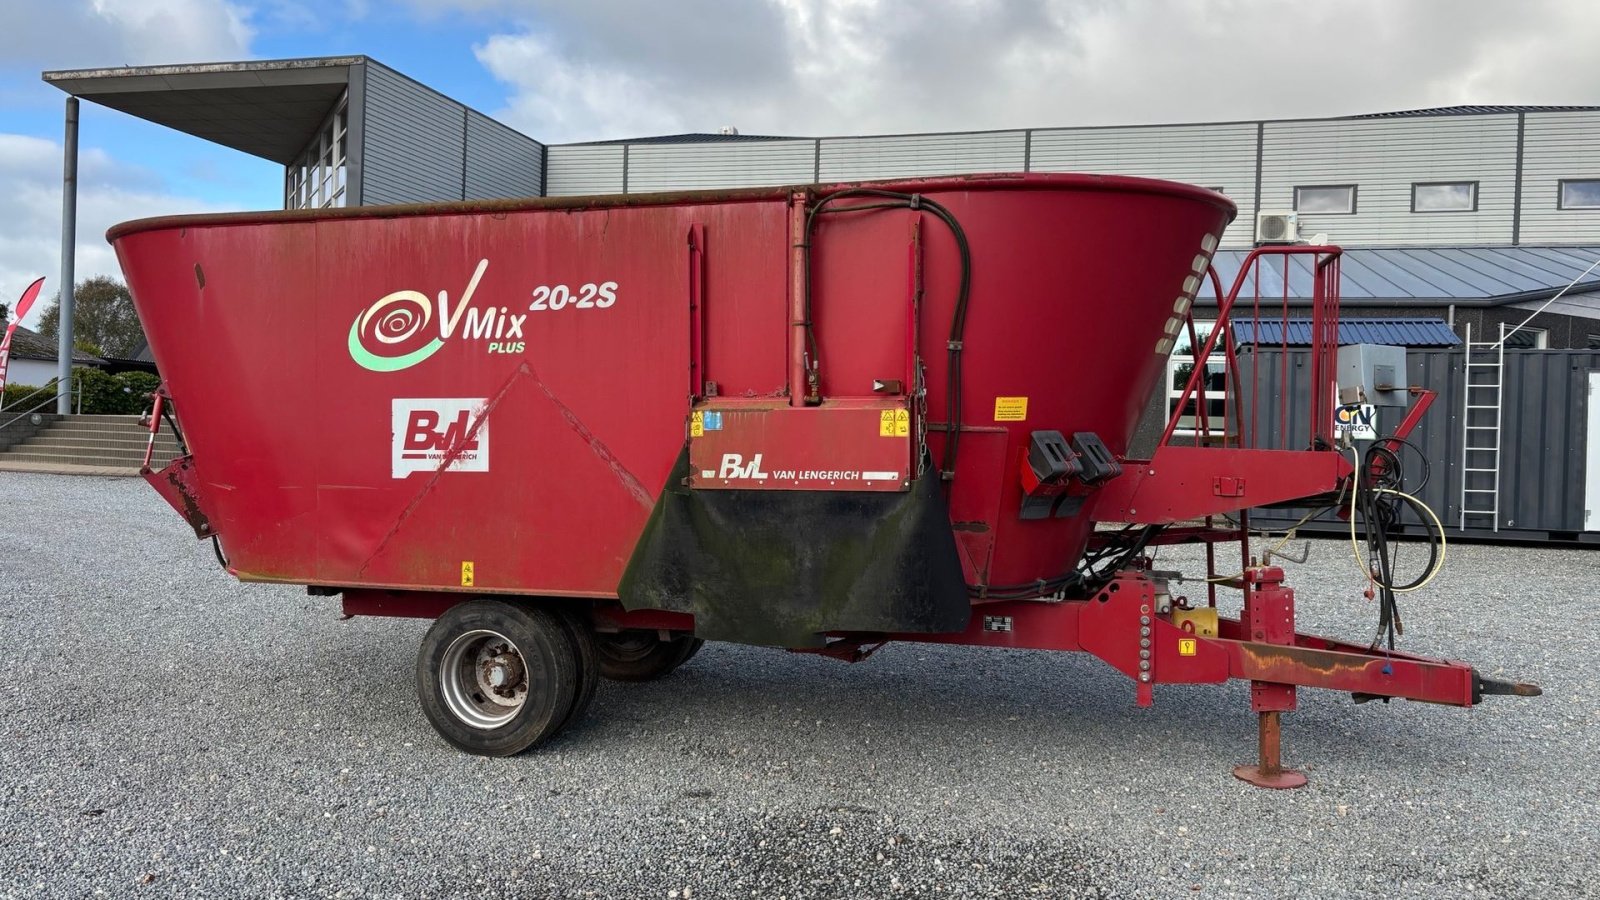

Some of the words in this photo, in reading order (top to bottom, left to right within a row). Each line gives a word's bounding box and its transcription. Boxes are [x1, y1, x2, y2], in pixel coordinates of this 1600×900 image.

[529, 281, 619, 311] 20-2S
[488, 341, 525, 354] PLUS
[773, 470, 796, 480] VAN
[799, 470, 860, 480] LENGERICH
